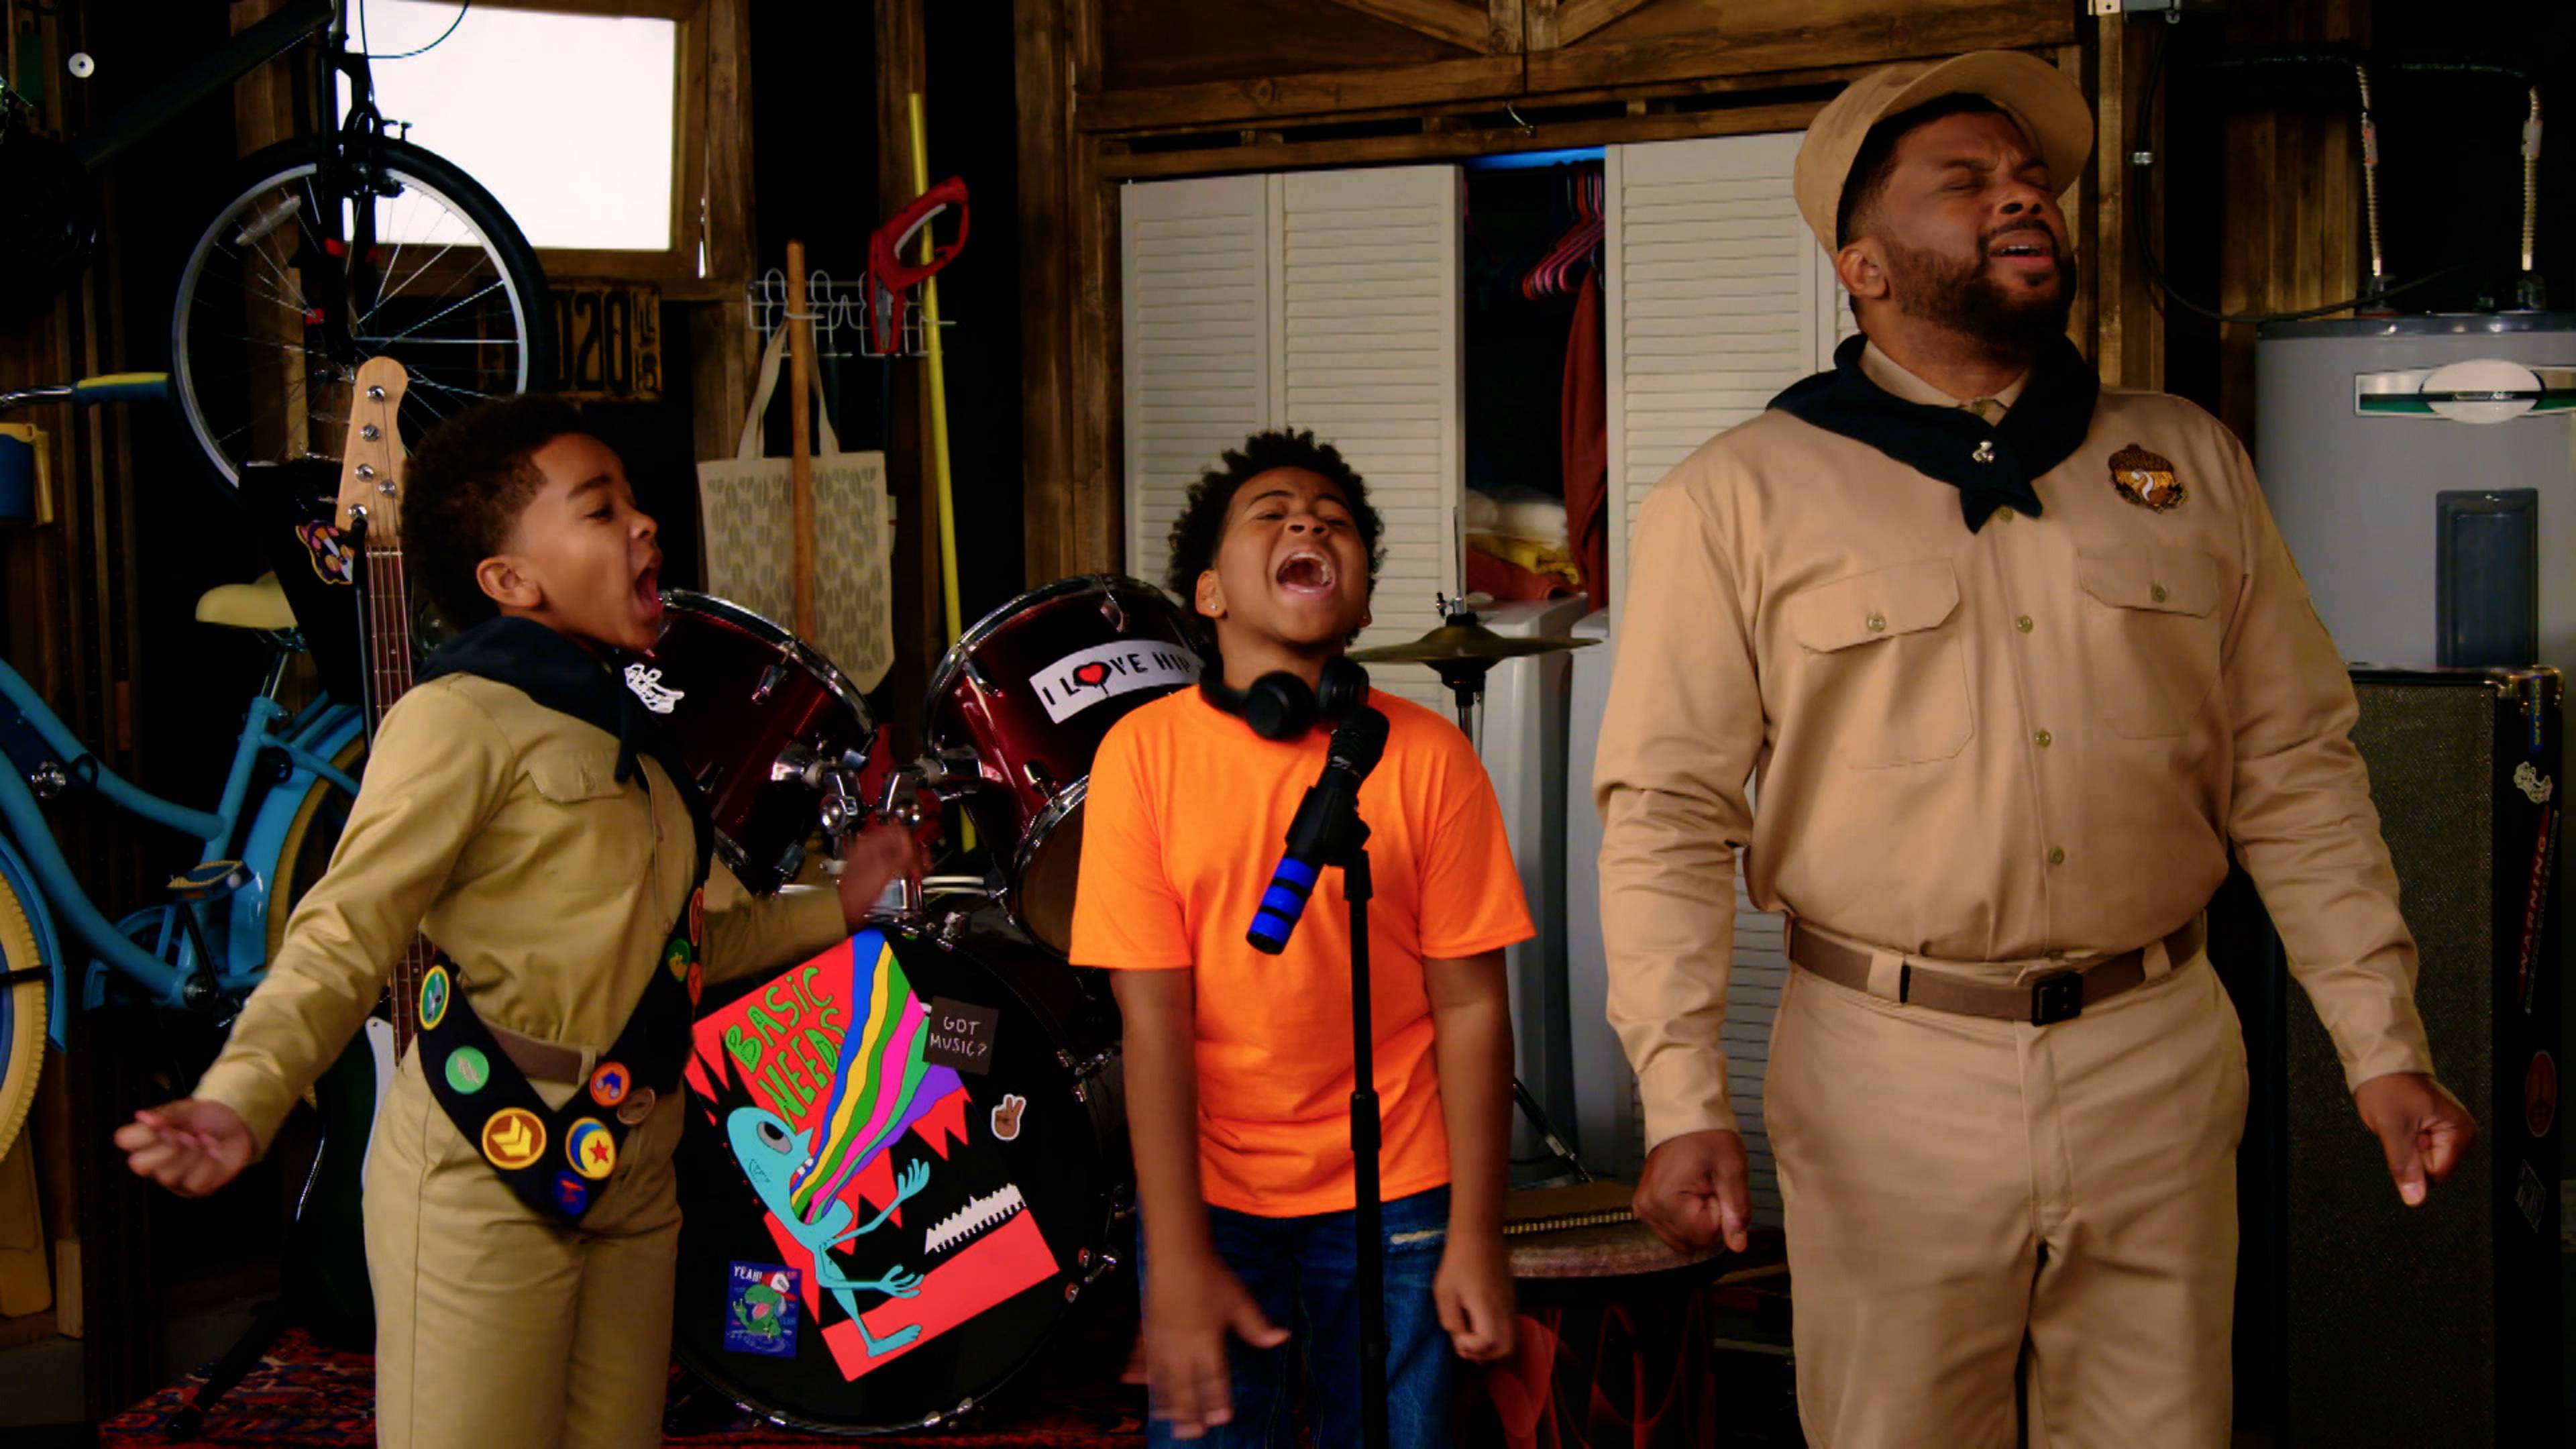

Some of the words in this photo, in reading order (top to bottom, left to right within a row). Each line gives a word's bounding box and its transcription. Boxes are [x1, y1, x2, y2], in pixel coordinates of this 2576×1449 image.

[1042, 686, 1056, 705] I
[944, 1016, 981, 1035] GOT
[930, 1032, 987, 1057] MUSIC?
[757, 1008, 847, 1134] NEEDS
[734, 1265, 763, 1282] YEAH!
